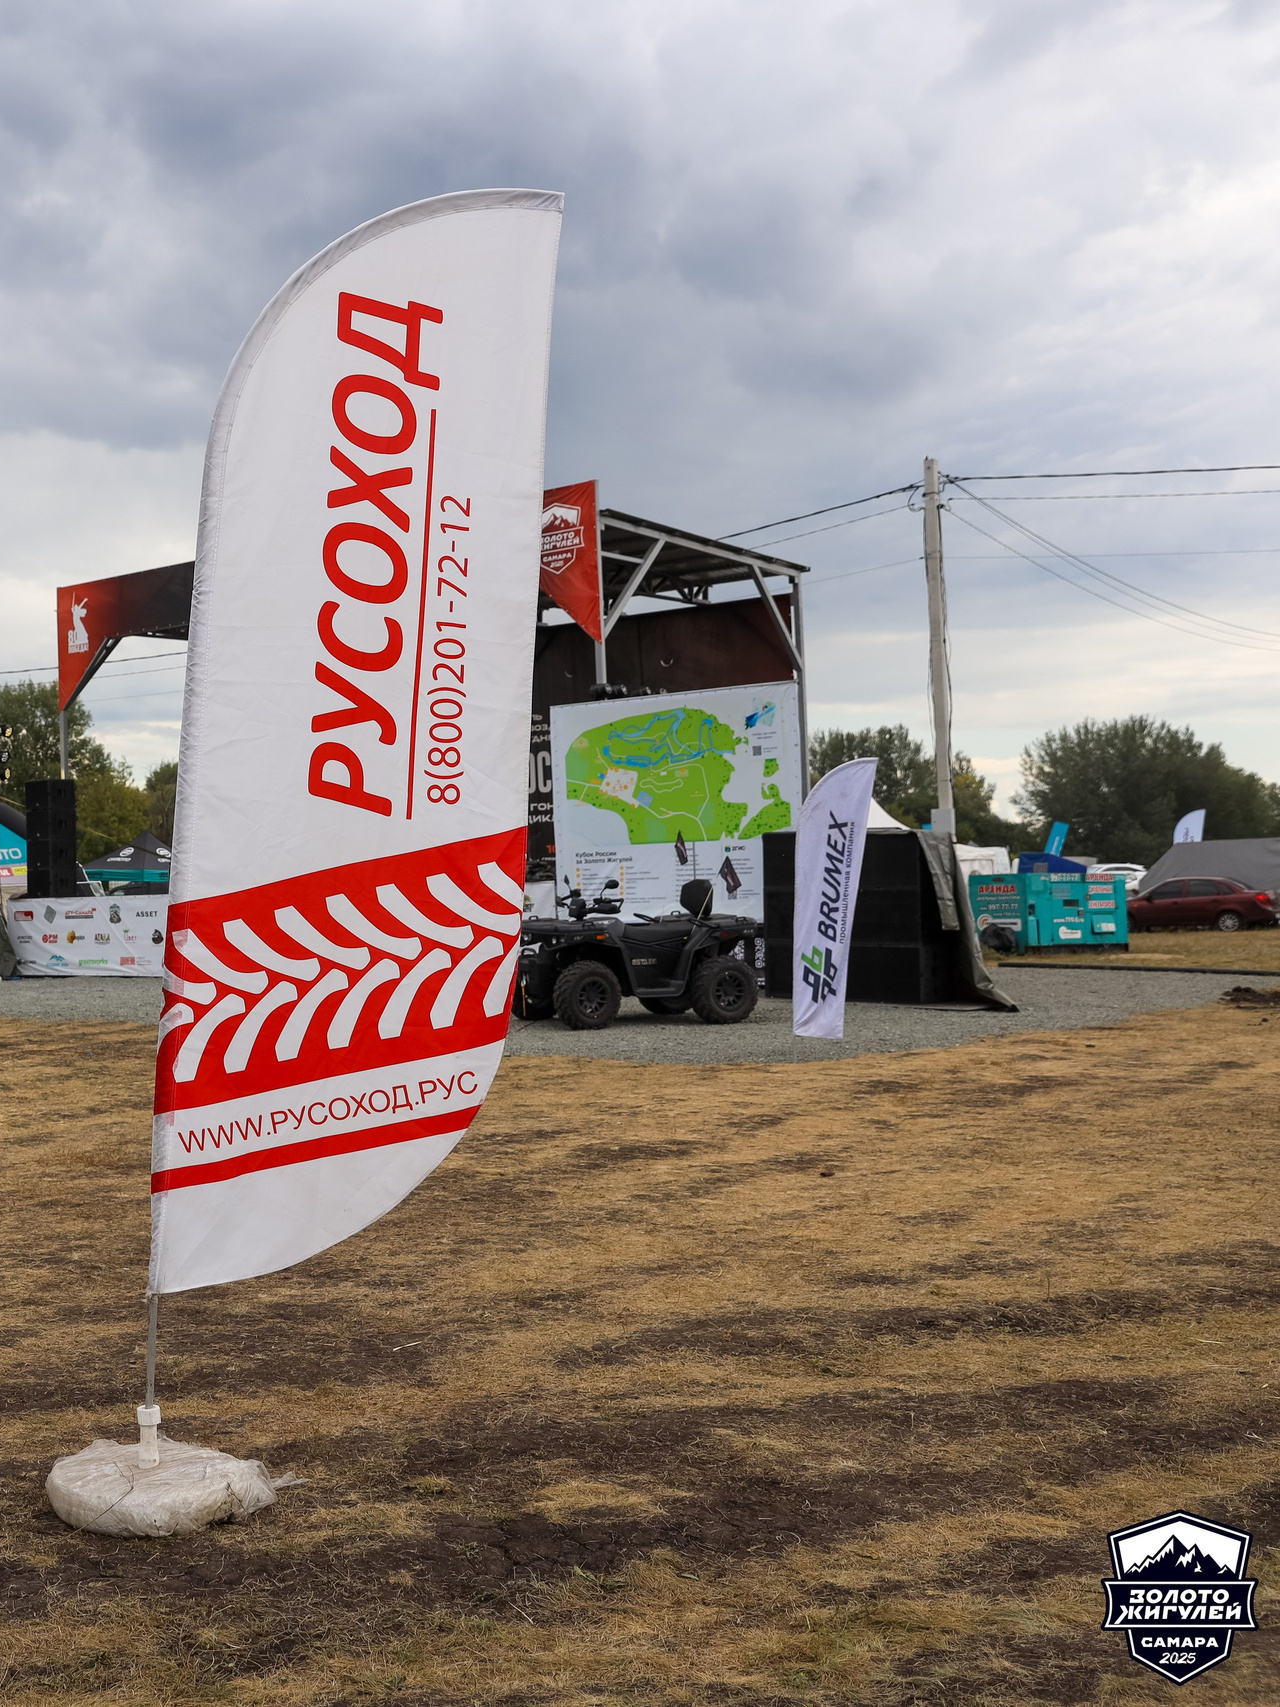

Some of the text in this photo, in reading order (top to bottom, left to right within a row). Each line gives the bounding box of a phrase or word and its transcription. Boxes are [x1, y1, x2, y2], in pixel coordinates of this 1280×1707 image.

[308, 292, 443, 816] РУСОХОД
[543, 552, 572, 562] САМАРА
[424, 496, 471, 806] 8(800)201-72-12
[818, 810, 848, 943] BRUMEX
[839, 821, 855, 944] промышленная компания
[978, 885, 1017, 894] АРЕНДА
[178, 1070, 478, 1153] WWW.РУСОХОД.РУС
